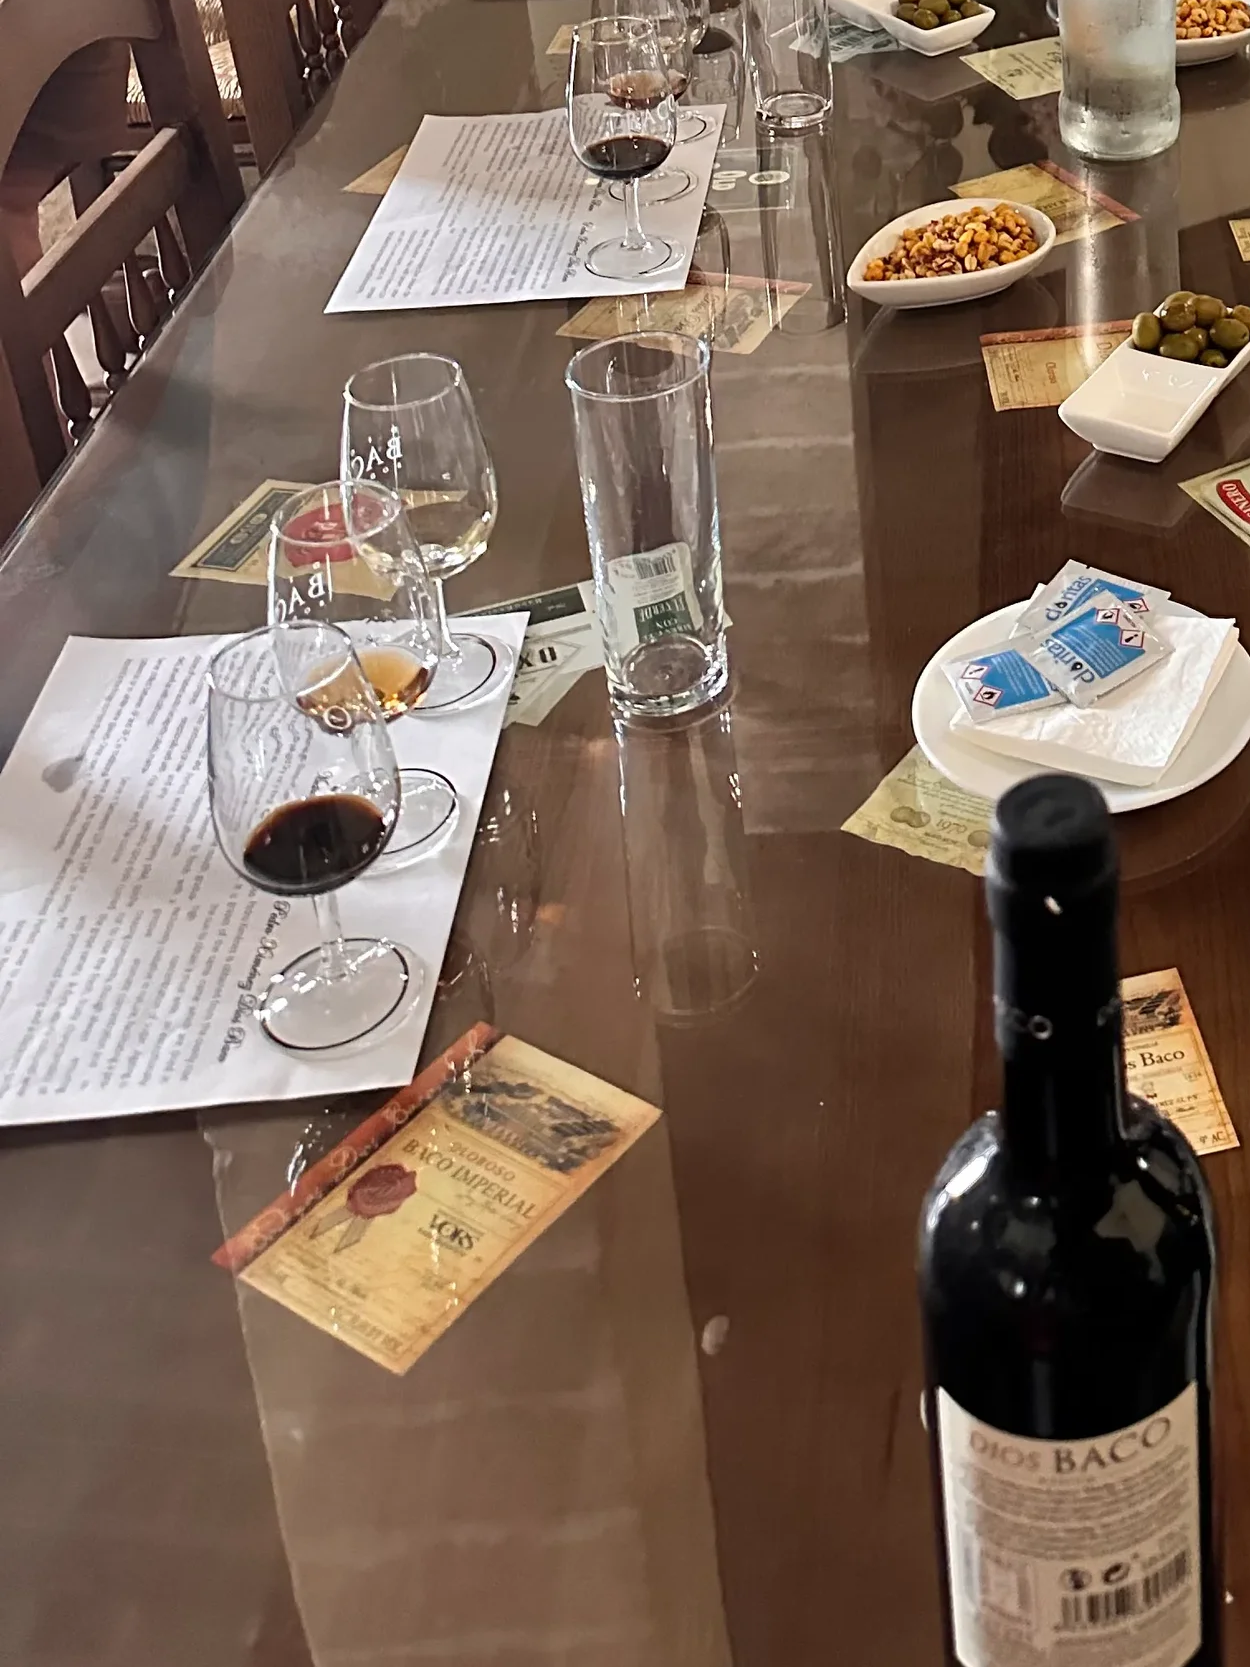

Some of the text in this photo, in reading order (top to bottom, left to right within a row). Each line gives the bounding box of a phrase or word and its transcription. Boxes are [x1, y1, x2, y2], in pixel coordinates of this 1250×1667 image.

[1139, 1049, 1186, 1069] Baco
[451, 1168, 537, 1221] IMPERIAL
[1052, 1416, 1172, 1475] BACO
